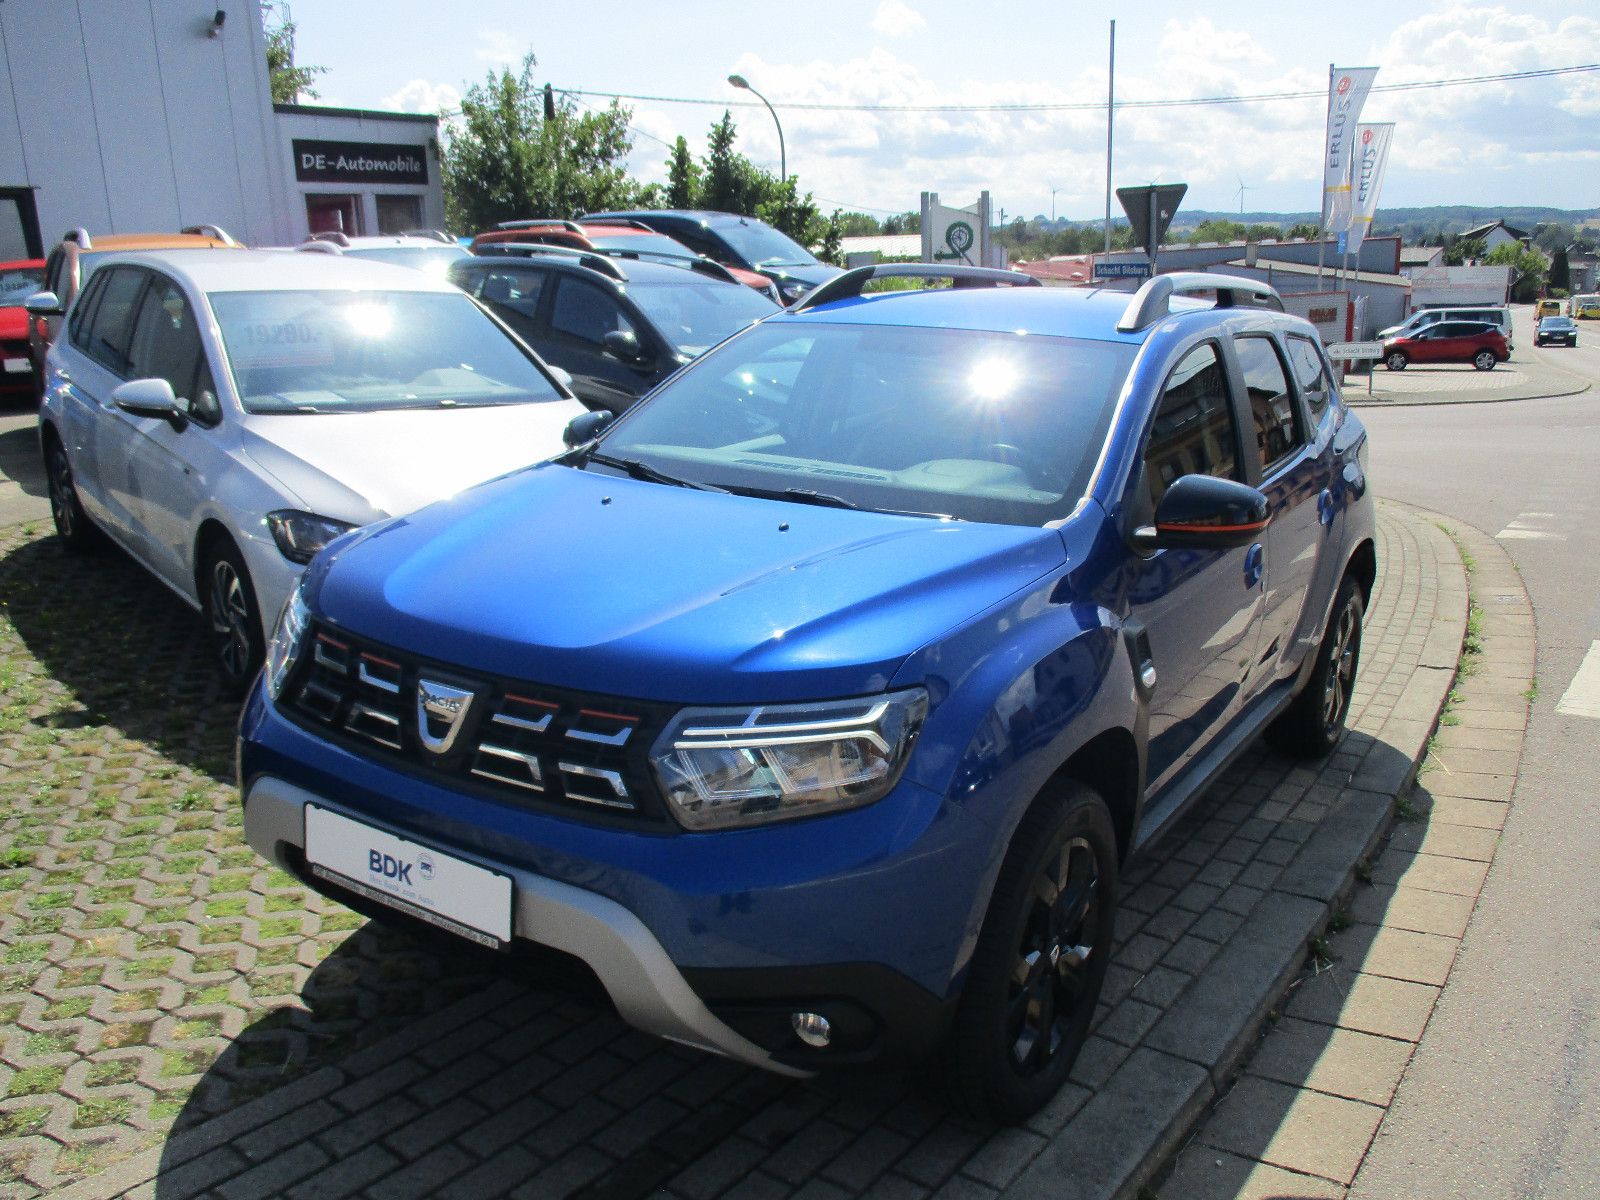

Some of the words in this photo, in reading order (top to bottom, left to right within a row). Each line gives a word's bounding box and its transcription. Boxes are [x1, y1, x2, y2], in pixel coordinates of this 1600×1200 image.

[1330, 99, 1352, 169] ERLUS
[301, 152, 421, 172] DE-Automobile
[1357, 147, 1377, 202] ERLUS
[369, 848, 413, 886] BDK
